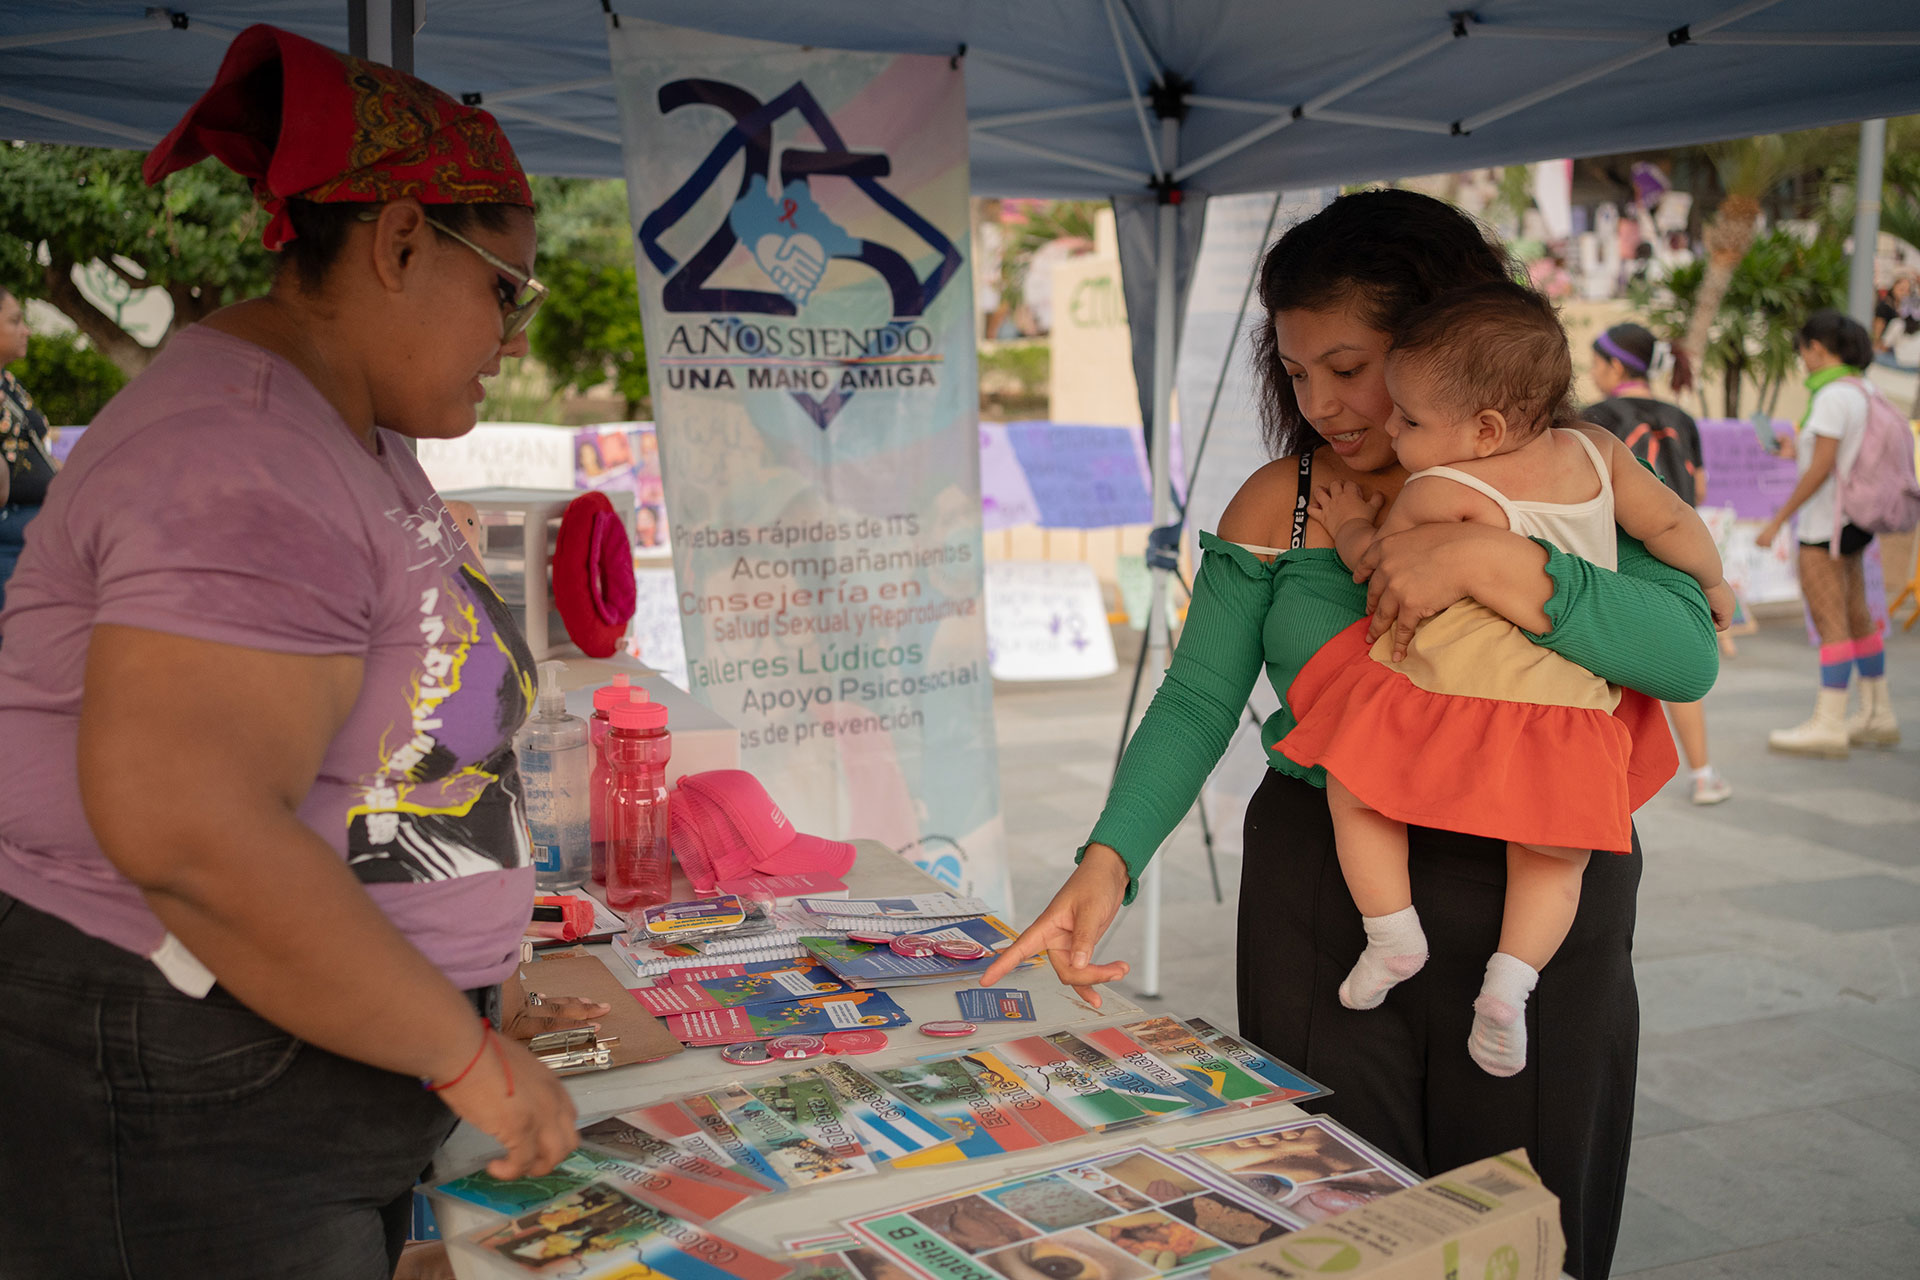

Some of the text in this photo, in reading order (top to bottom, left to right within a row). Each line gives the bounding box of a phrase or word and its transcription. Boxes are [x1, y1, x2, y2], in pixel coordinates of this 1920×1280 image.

[657, 78, 927, 317] 25
[667, 366, 936, 391] UNA MANO AMIGA
[757, 520, 852, 548] rápidas
[856, 518, 882, 540] de
[886, 513, 920, 537] ITS
[731, 543, 972, 582] Acompañamientos
[680, 579, 923, 616] Consejería en
[714, 615, 770, 643] Salud
[774, 607, 851, 637] Sexual
[855, 612, 867, 637] y
[688, 641, 924, 690] Talleres Lúdicos
[742, 660, 980, 716] Apoyo Psicosocial
[764, 722, 789, 744] de
[794, 705, 925, 746] prevención
[1174, 1042, 1230, 1074] Brasil
[1220, 1043, 1267, 1071] Cuba
[850, 1083, 906, 1123] Grecia
[950, 1080, 1010, 1130] Ecuador
[994, 1080, 1042, 1112] Chile
[807, 1096, 857, 1158] Inglaterra
[595, 1158, 672, 1193] China
[623, 1203, 740, 1267] Colombia
[888, 1226, 919, 1241] B
